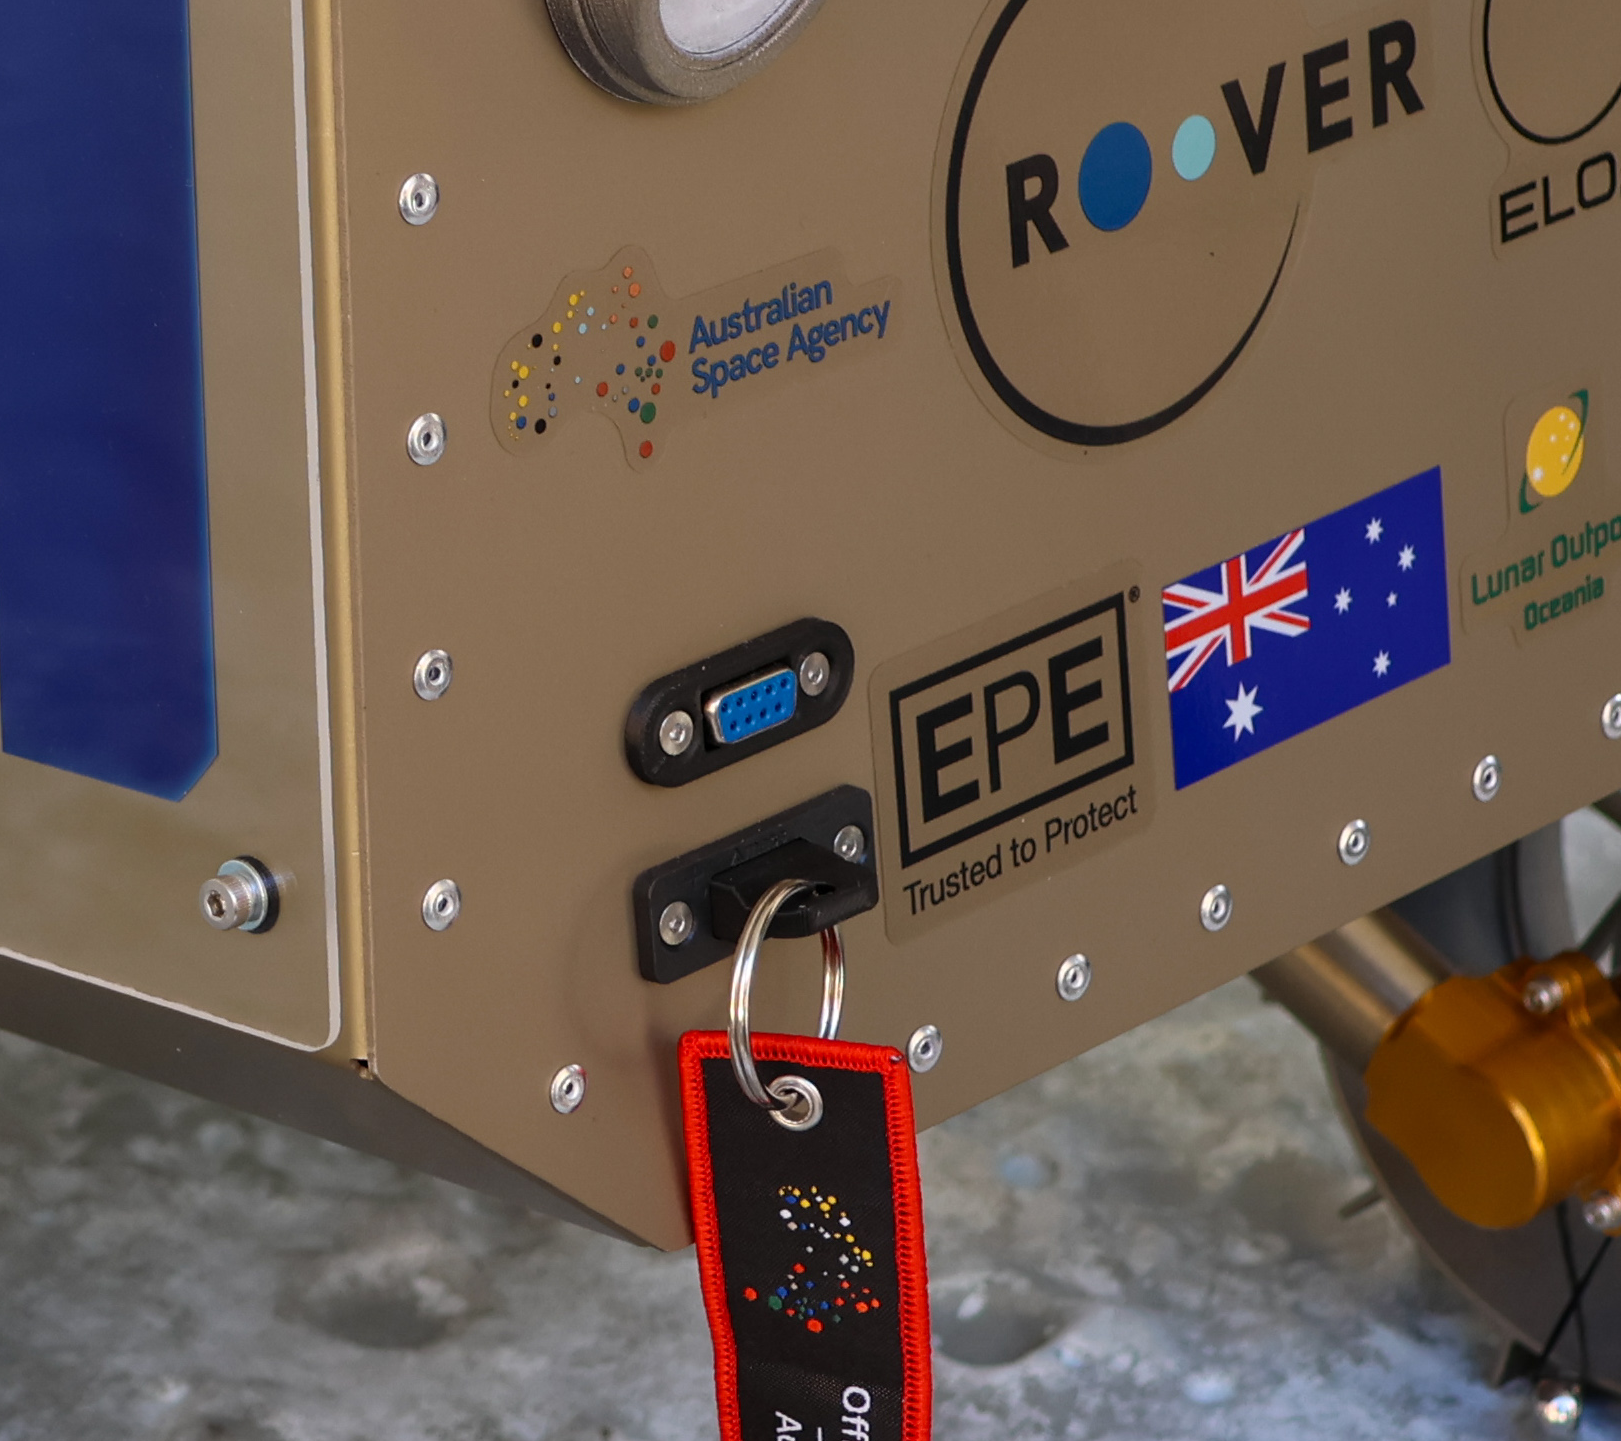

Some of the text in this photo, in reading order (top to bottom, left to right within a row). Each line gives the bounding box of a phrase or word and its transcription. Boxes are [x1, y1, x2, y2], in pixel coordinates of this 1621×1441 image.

[689, 280, 833, 353] Australian
[692, 301, 890, 398] Space Agency
[1472, 551, 1545, 605] Lunar
[1525, 576, 1604, 631] Oceania
[916, 636, 1110, 823] EPE
[903, 785, 1138, 916] Trusted to Protect
